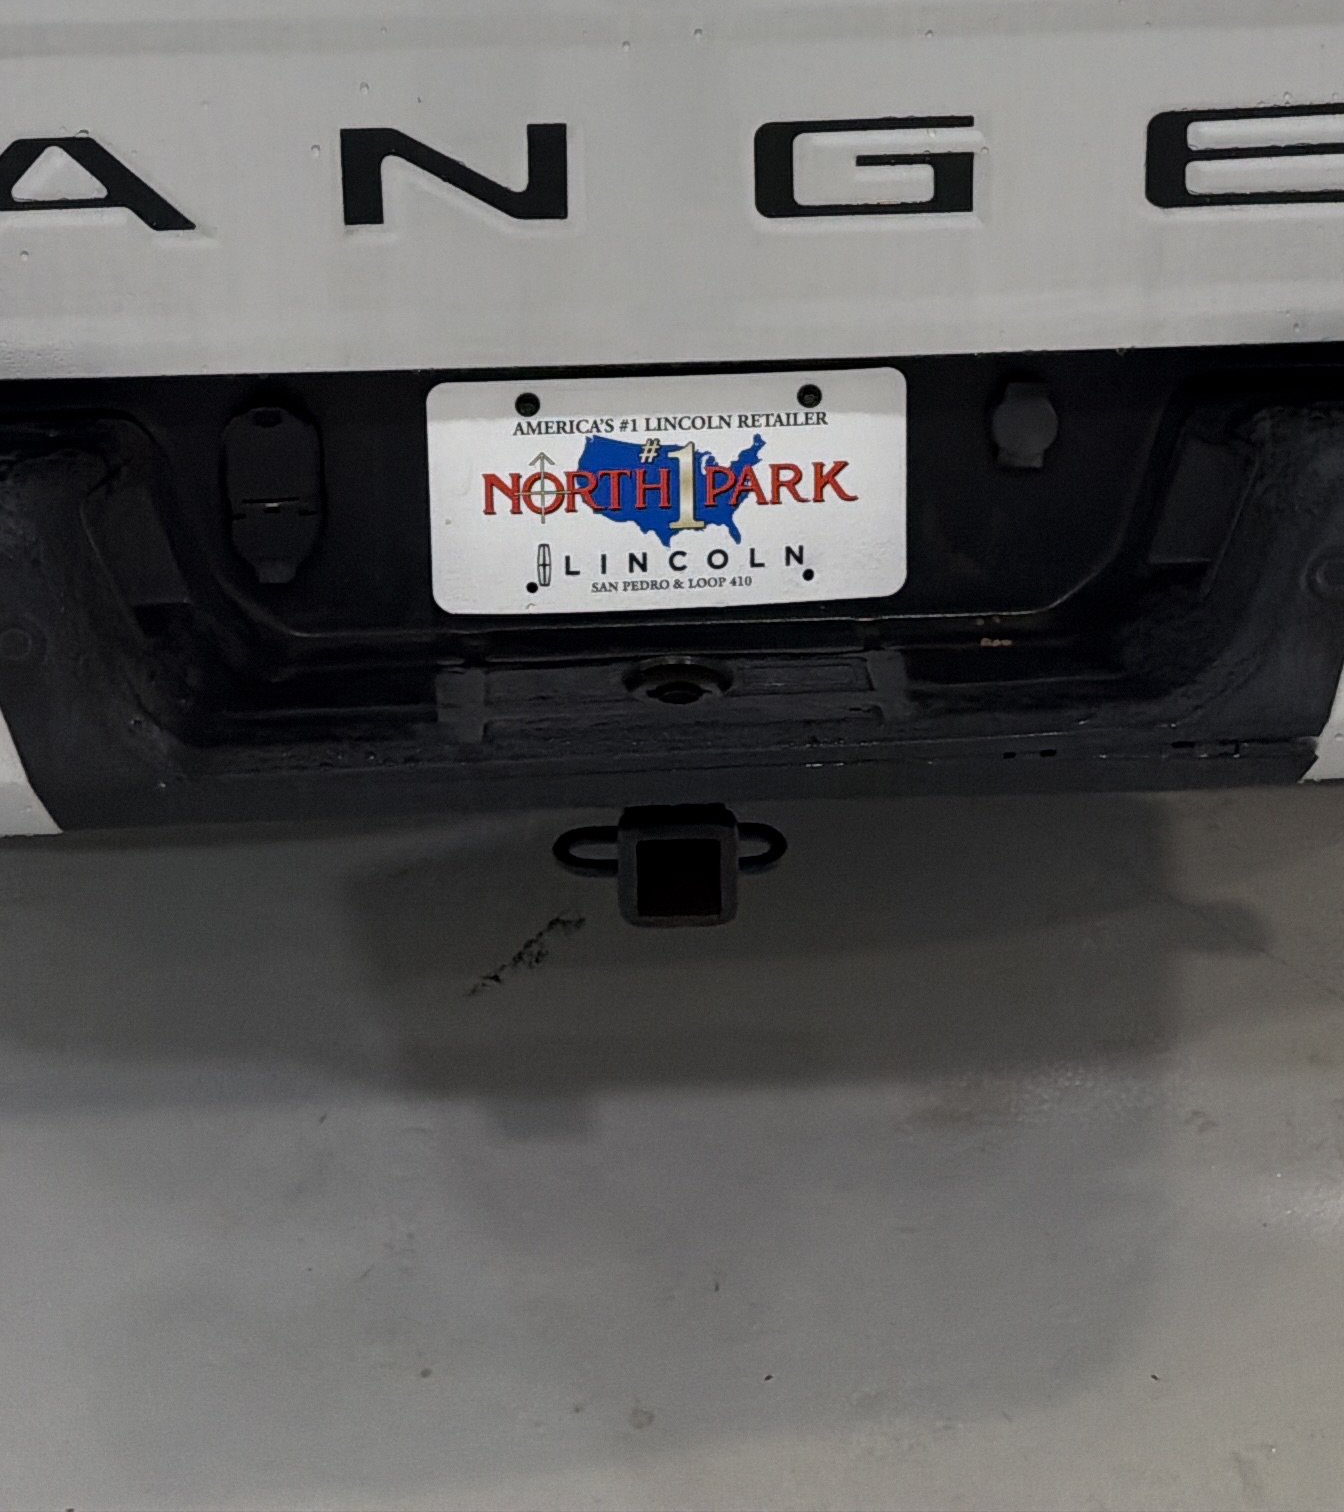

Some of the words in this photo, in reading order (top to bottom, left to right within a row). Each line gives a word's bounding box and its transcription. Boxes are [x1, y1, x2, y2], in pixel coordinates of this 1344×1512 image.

[513, 418, 615, 436] AMERICA'S
[619, 418, 638, 432] #1
[644, 414, 732, 432] LINCOLN
[737, 411, 828, 429] RETAILER
[482, 468, 672, 515] NORTH
[705, 460, 859, 508] PARK
[564, 544, 804, 576] LINCOLN
[591, 581, 620, 593] SAN
[622, 579, 670, 592] PEDRO
[672, 578, 686, 590] &
[688, 576, 727, 589] LOOP
[729, 575, 752, 587] 410
